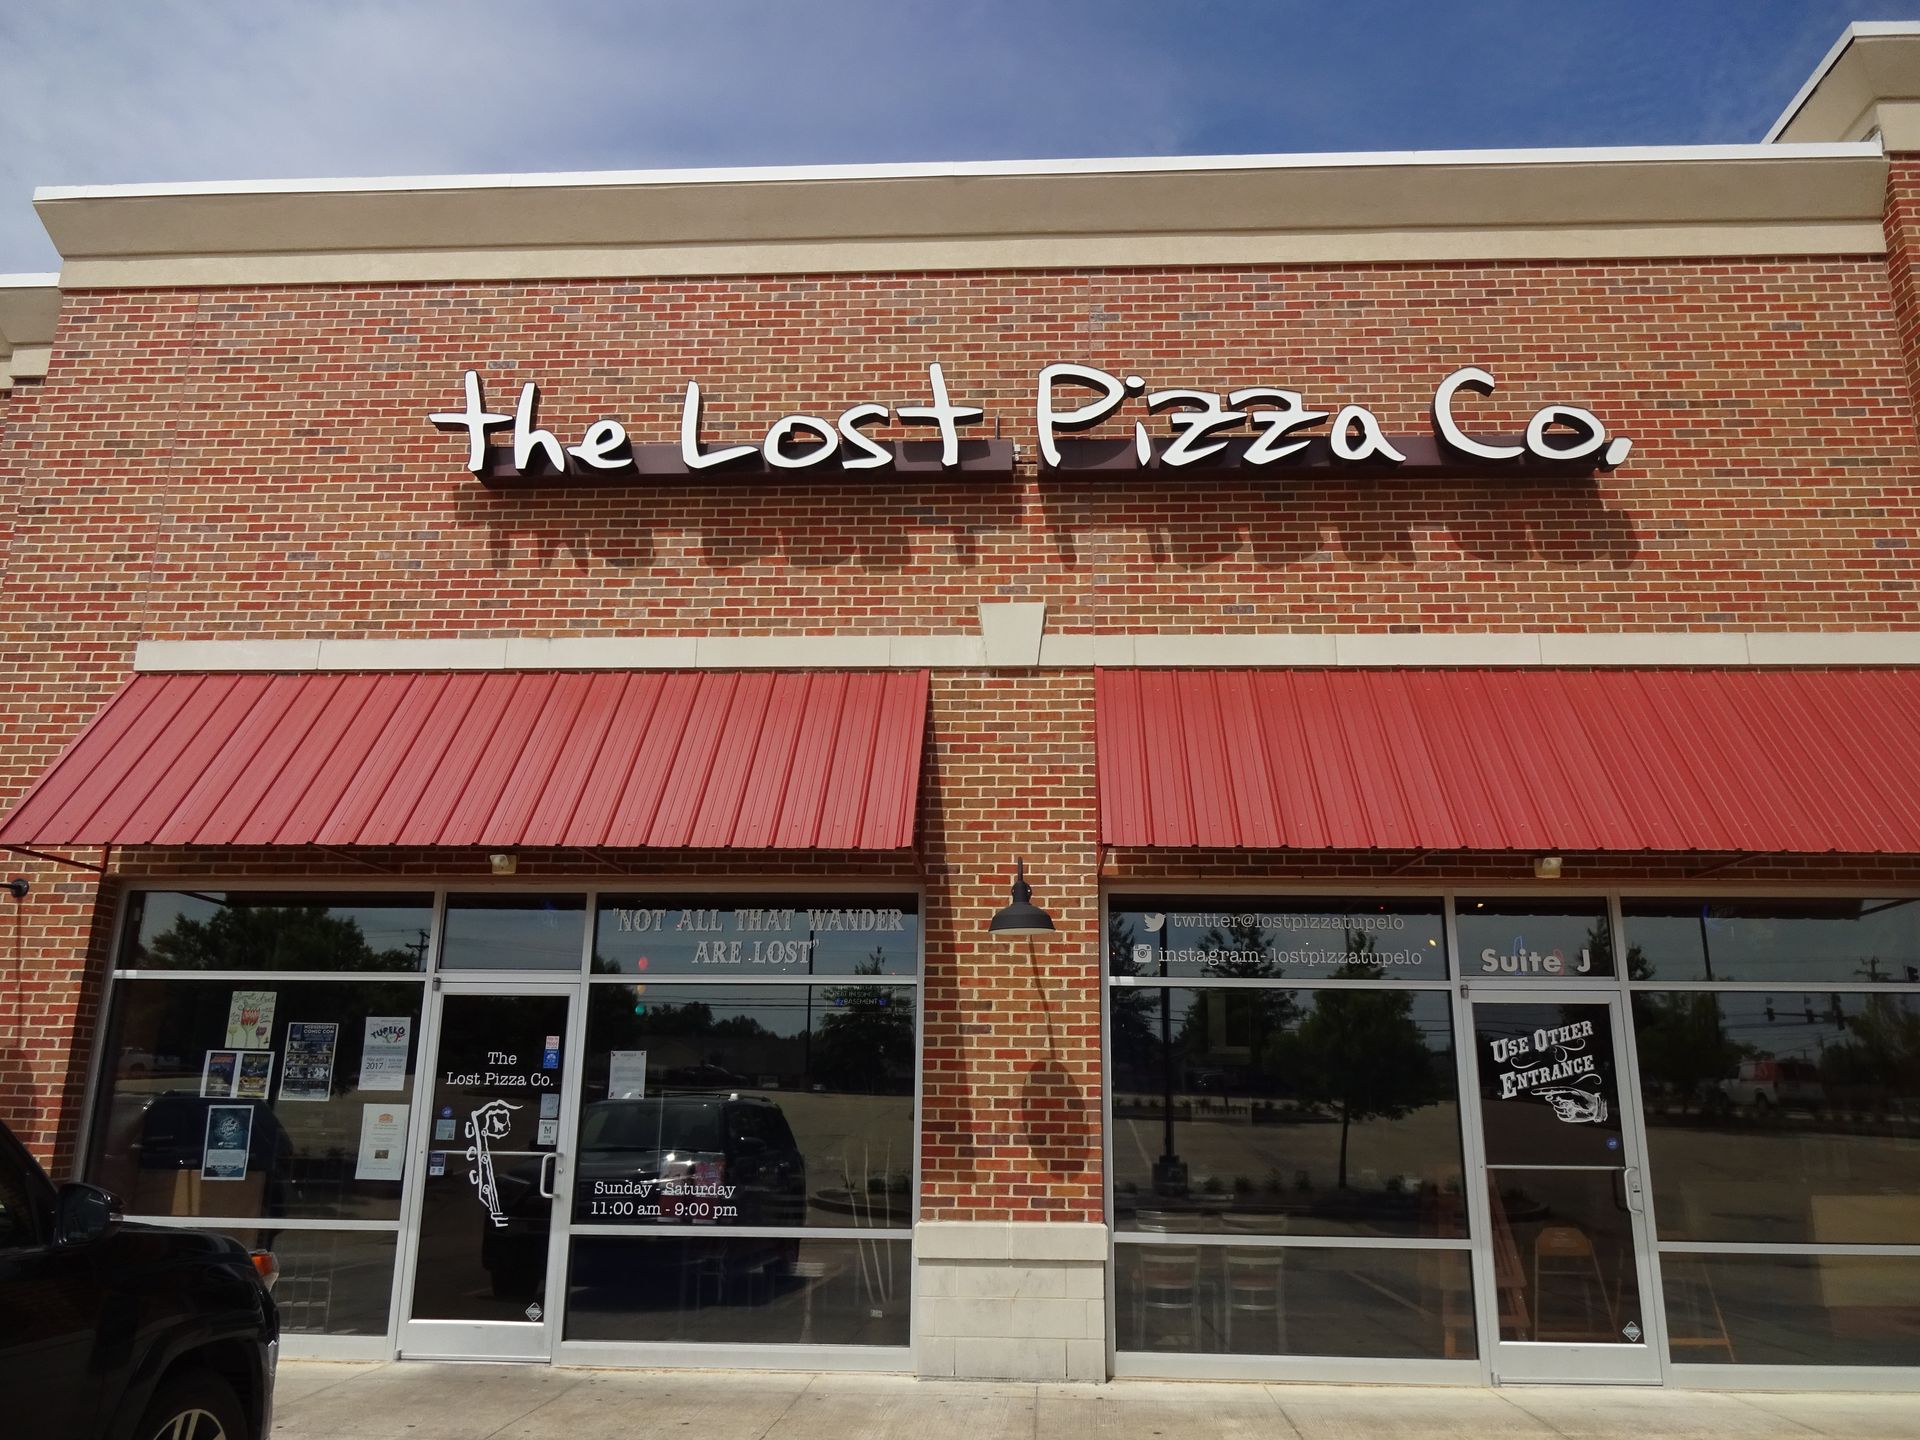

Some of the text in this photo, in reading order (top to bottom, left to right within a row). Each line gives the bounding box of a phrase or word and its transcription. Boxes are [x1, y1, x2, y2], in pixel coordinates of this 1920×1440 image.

[428, 362, 1633, 472] the Lost Pizza Co.
[676, 907, 724, 932] ALL
[735, 908, 797, 932] THAT
[807, 908, 905, 932] WANDER
[1173, 913, 1404, 931] twitter@lostpizzatupelo
[692, 940, 742, 964] ARE
[1271, 948, 1422, 967] lostpizzatupelo
[1481, 948, 1591, 973] Suite J
[371, 1026, 406, 1039] TUPELO
[366, 1062, 384, 1070] 2017
[487, 1051, 517, 1065] The
[446, 1071, 554, 1086] Lost Pizza Co.
[594, 1180, 652, 1197] Sunday
[665, 1182, 737, 1199] Saturday
[591, 1202, 634, 1216] 11:00
[637, 1205, 662, 1217] am
[674, 1203, 710, 1217] 9:00
[713, 1206, 738, 1220] pm
